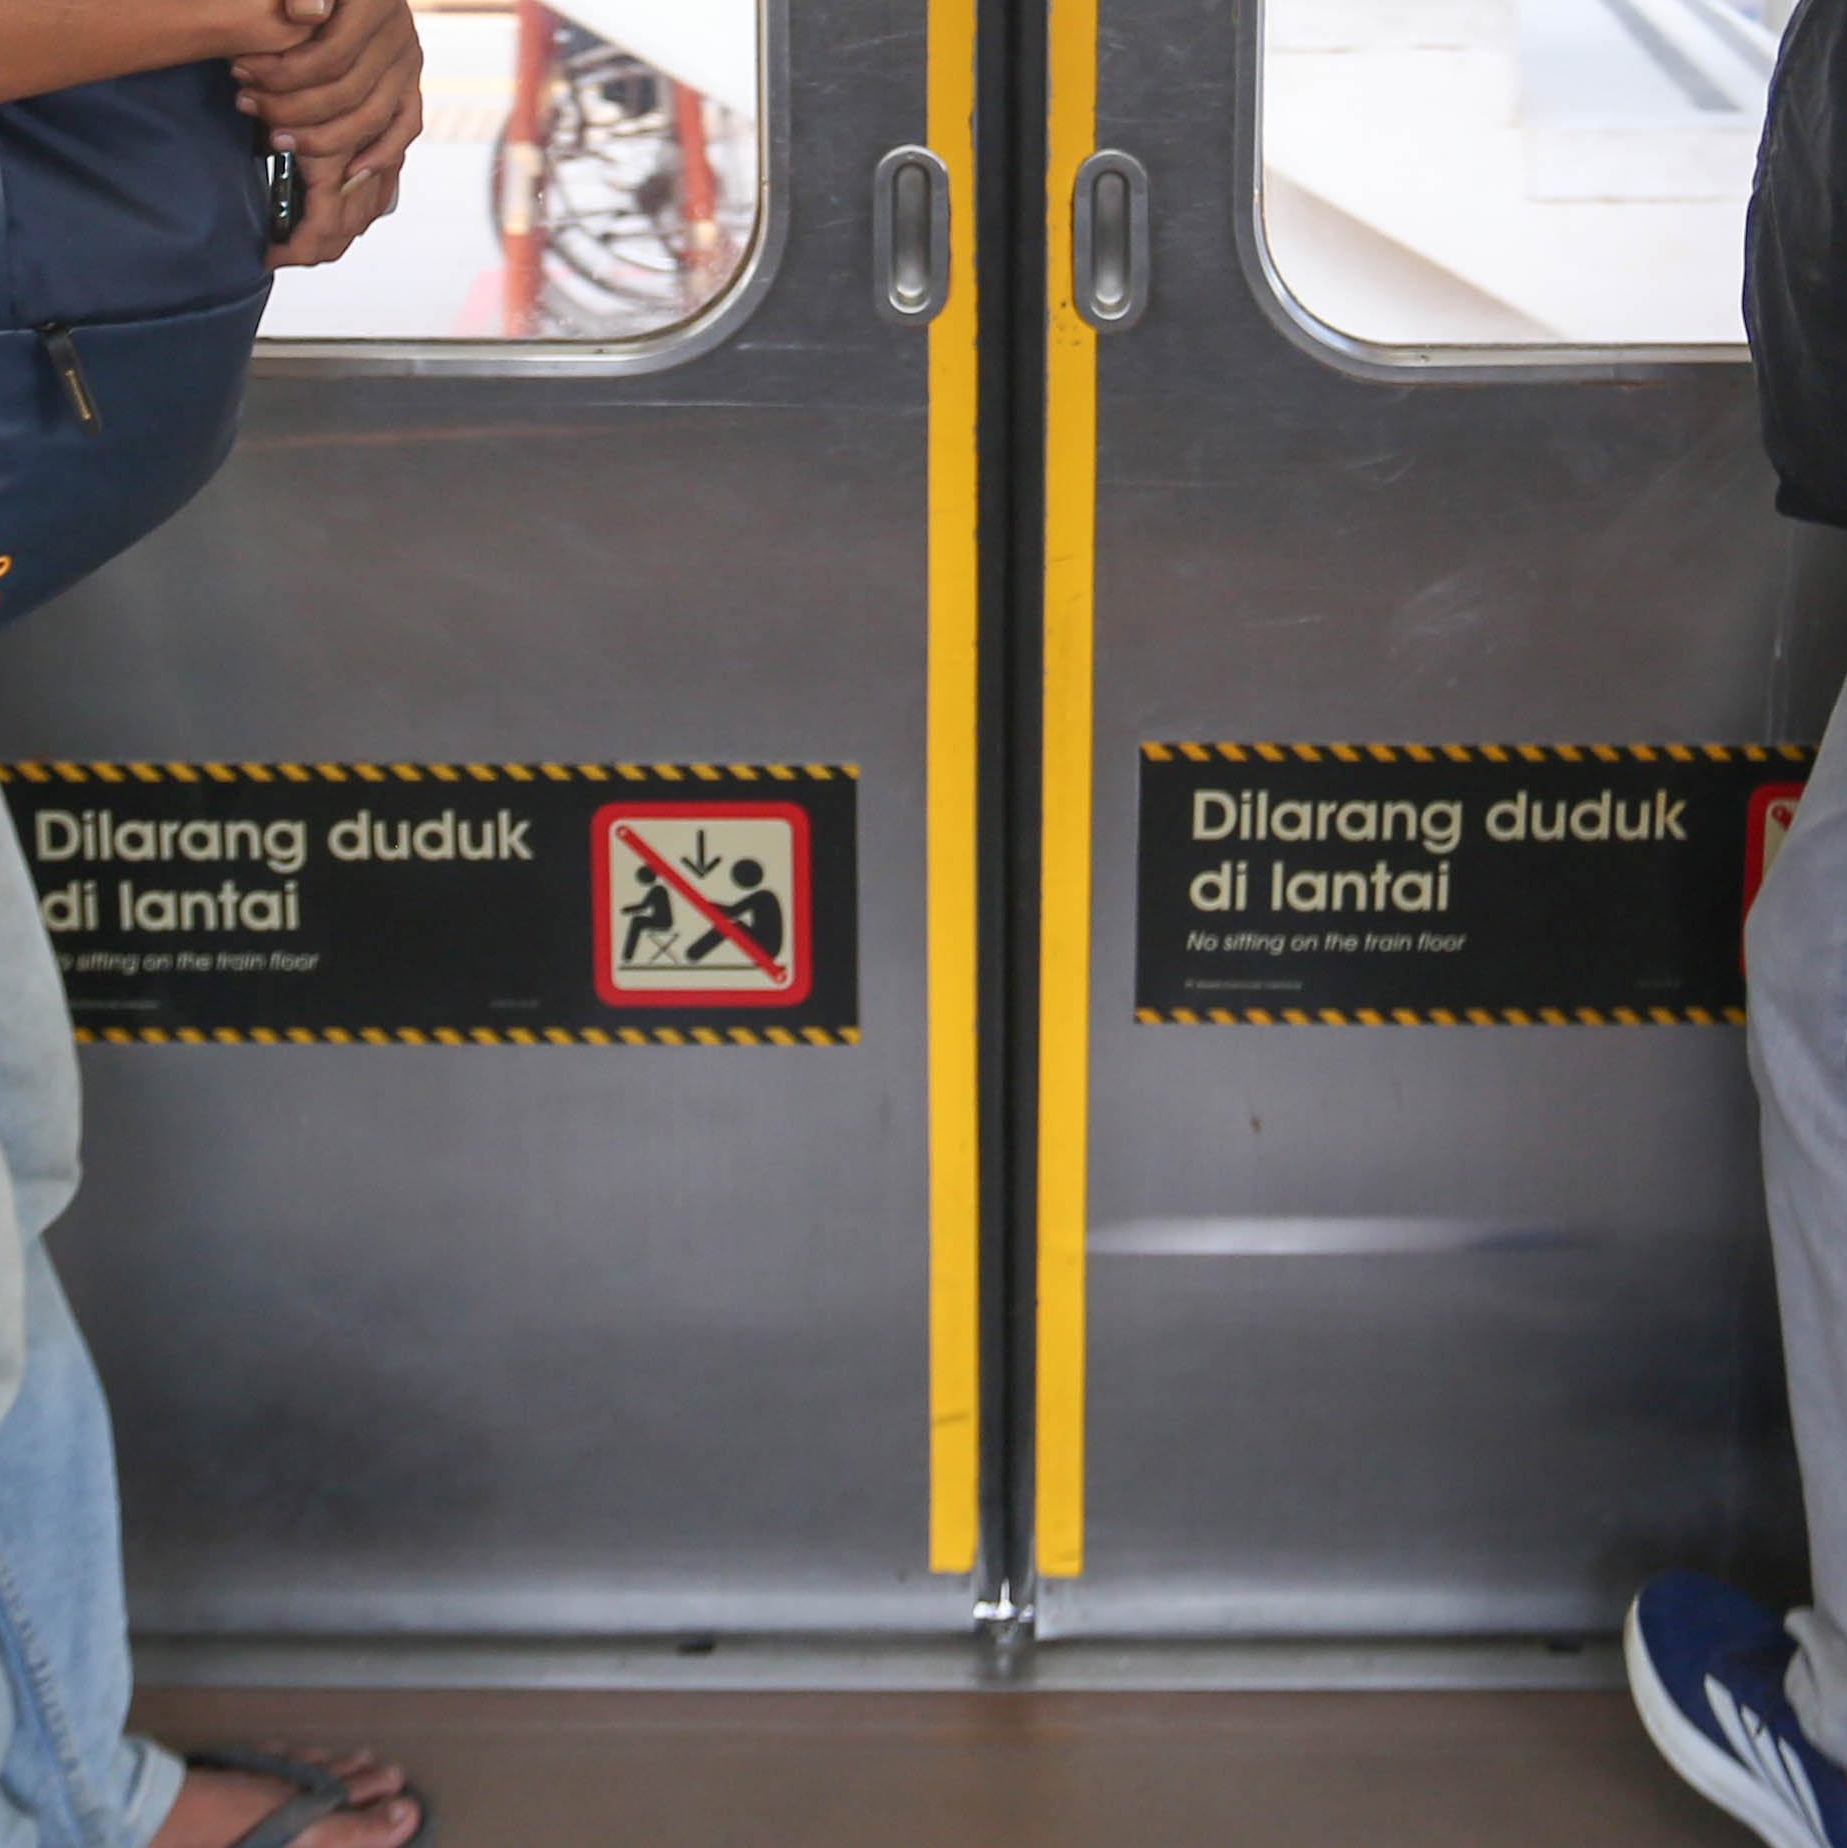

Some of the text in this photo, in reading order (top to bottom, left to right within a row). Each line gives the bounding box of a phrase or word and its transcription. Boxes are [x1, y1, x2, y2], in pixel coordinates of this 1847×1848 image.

[35, 809, 535, 873] Dilarang duduk
[1191, 789, 1688, 854] Dilarang duduk
[41, 881, 300, 931] di lantai
[1189, 861, 1450, 912] di lantai
[1186, 930, 1468, 956] No sitting on the train floor
